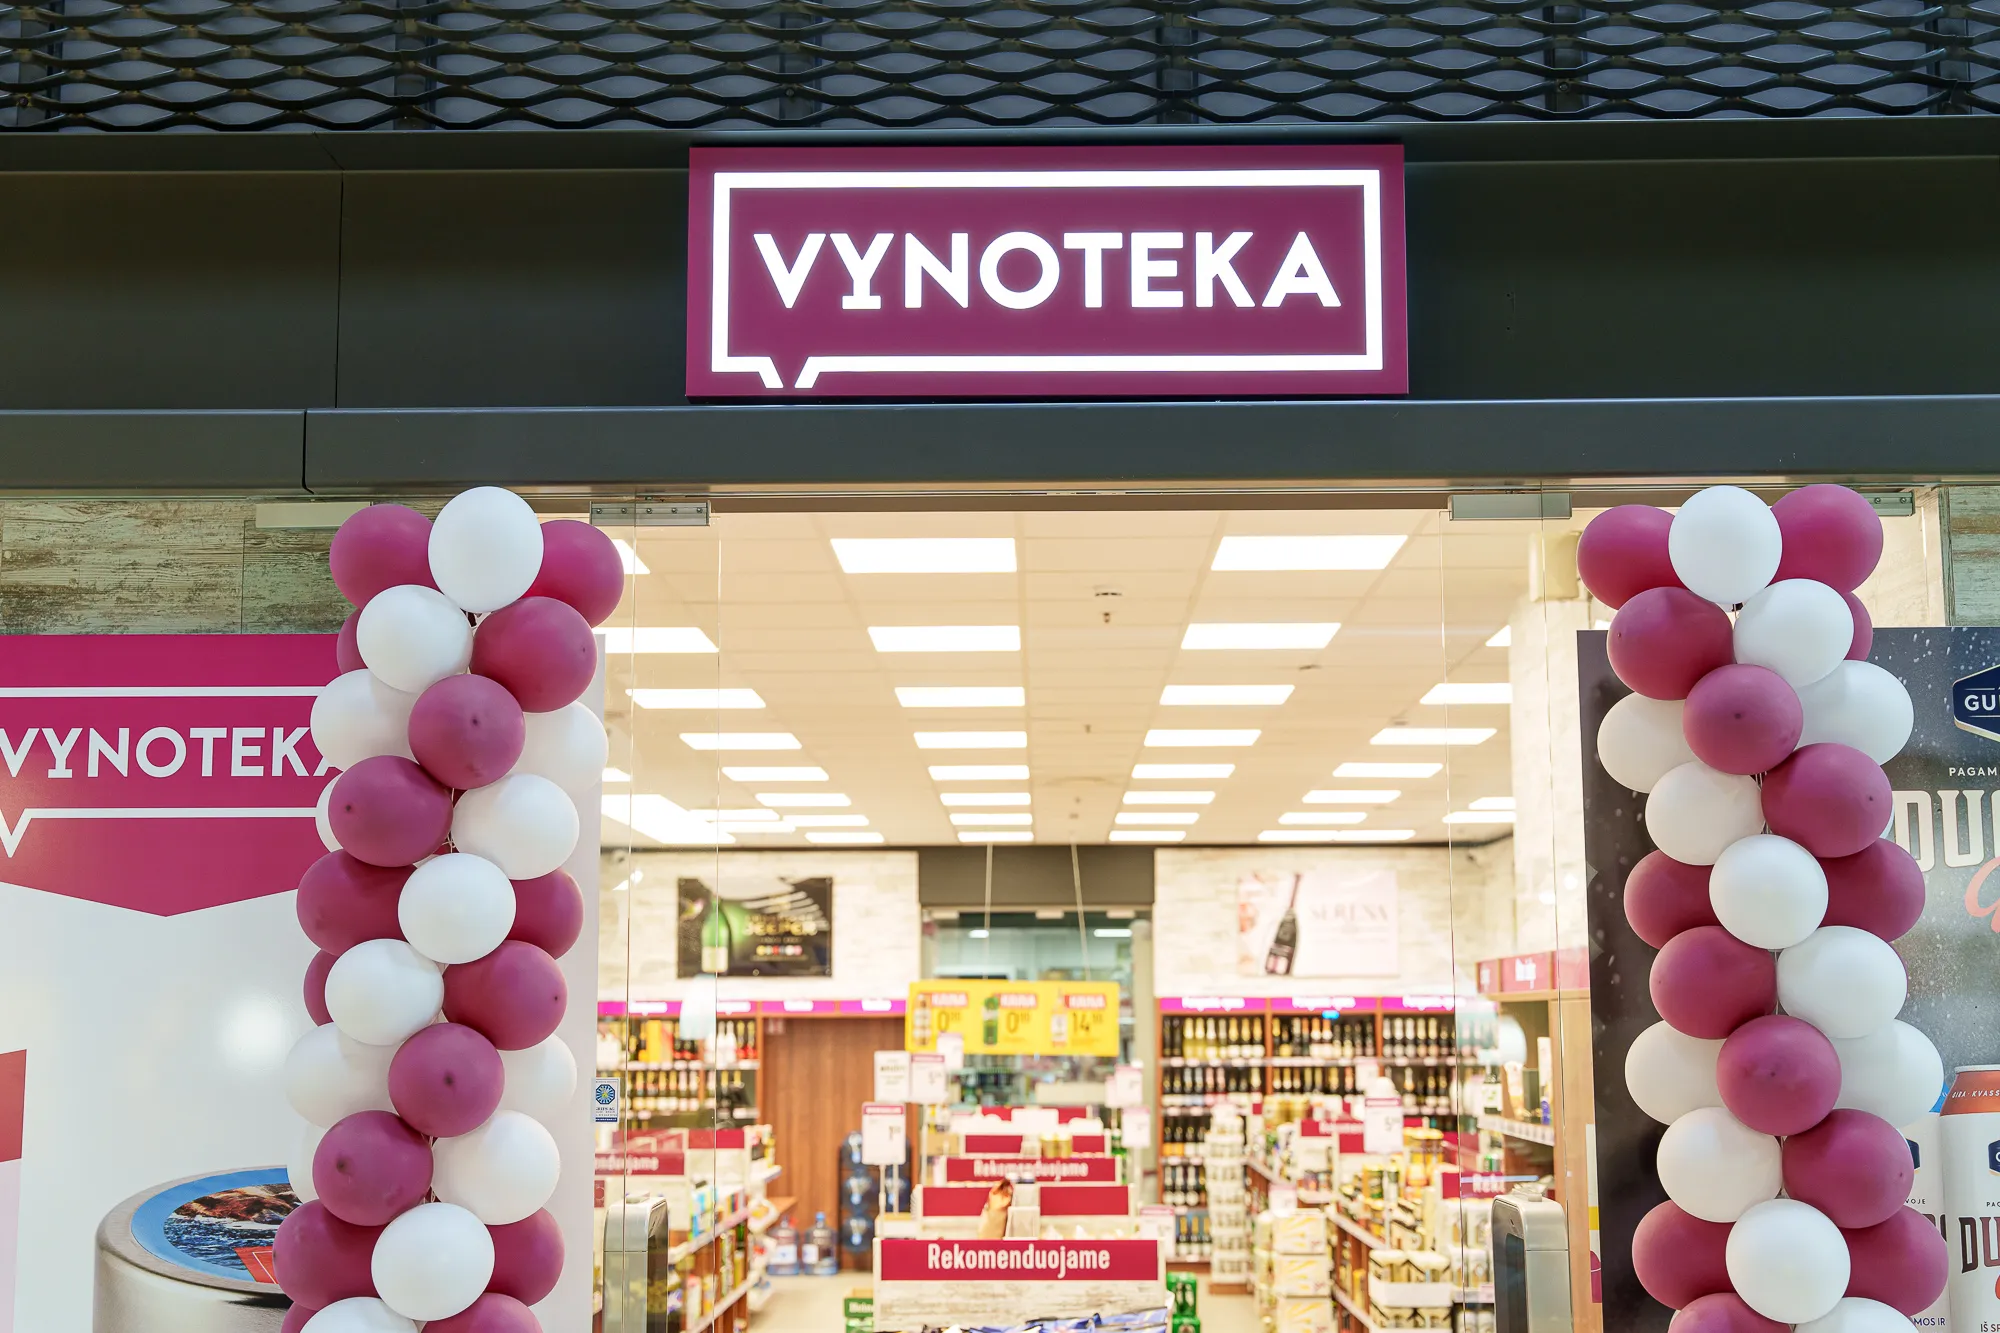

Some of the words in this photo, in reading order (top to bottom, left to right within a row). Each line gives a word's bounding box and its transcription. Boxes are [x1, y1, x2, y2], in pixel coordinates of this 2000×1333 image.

[753, 231, 1342, 309] VYNOTEKA
[1964, 694, 2000, 712] GU
[1892, 790, 2000, 872] DU
[1971, 1089, 2000, 1098] KVASS
[927, 1243, 1111, 1280] Rekomenduojame
